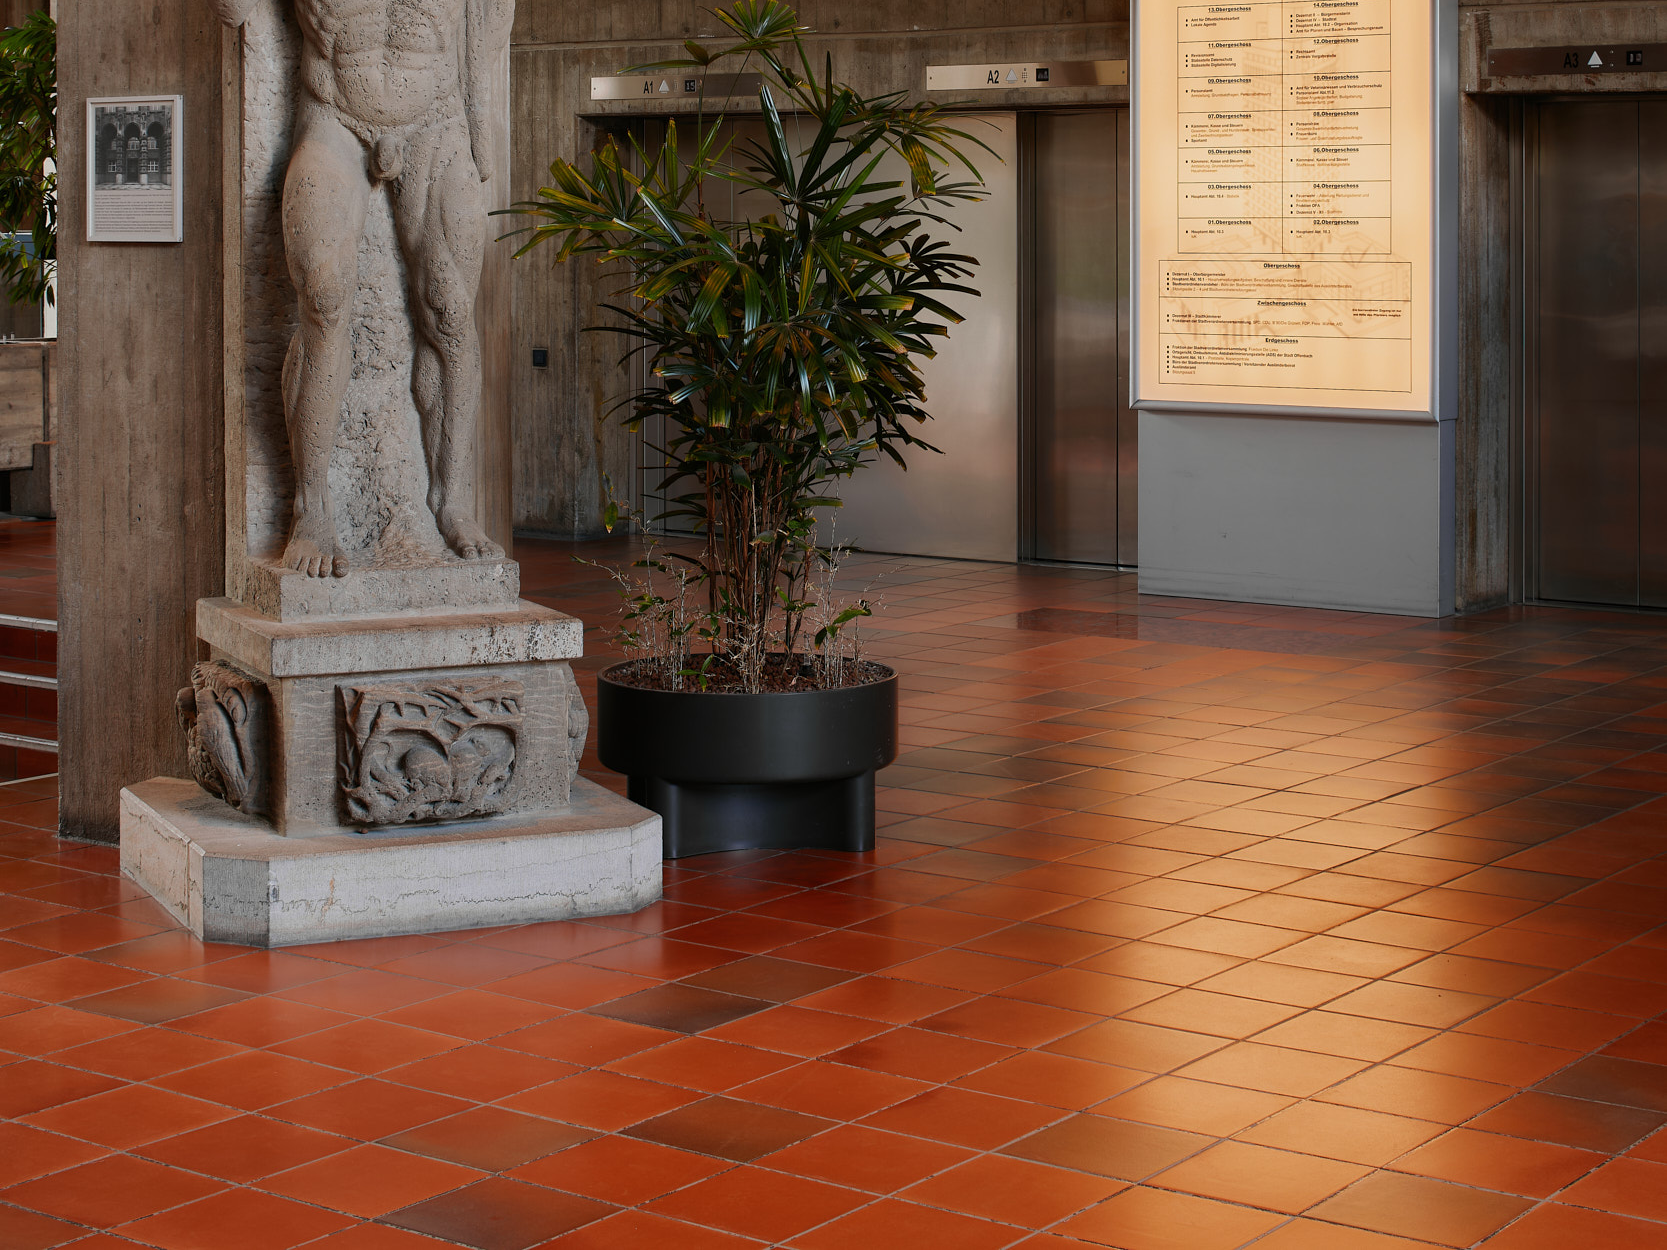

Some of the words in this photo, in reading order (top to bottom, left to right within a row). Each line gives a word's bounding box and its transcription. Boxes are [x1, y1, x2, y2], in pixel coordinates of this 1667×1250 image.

[1564, 53, 1578, 68] A3
[987, 70, 999, 84] A2
[643, 81, 653, 94] A1
